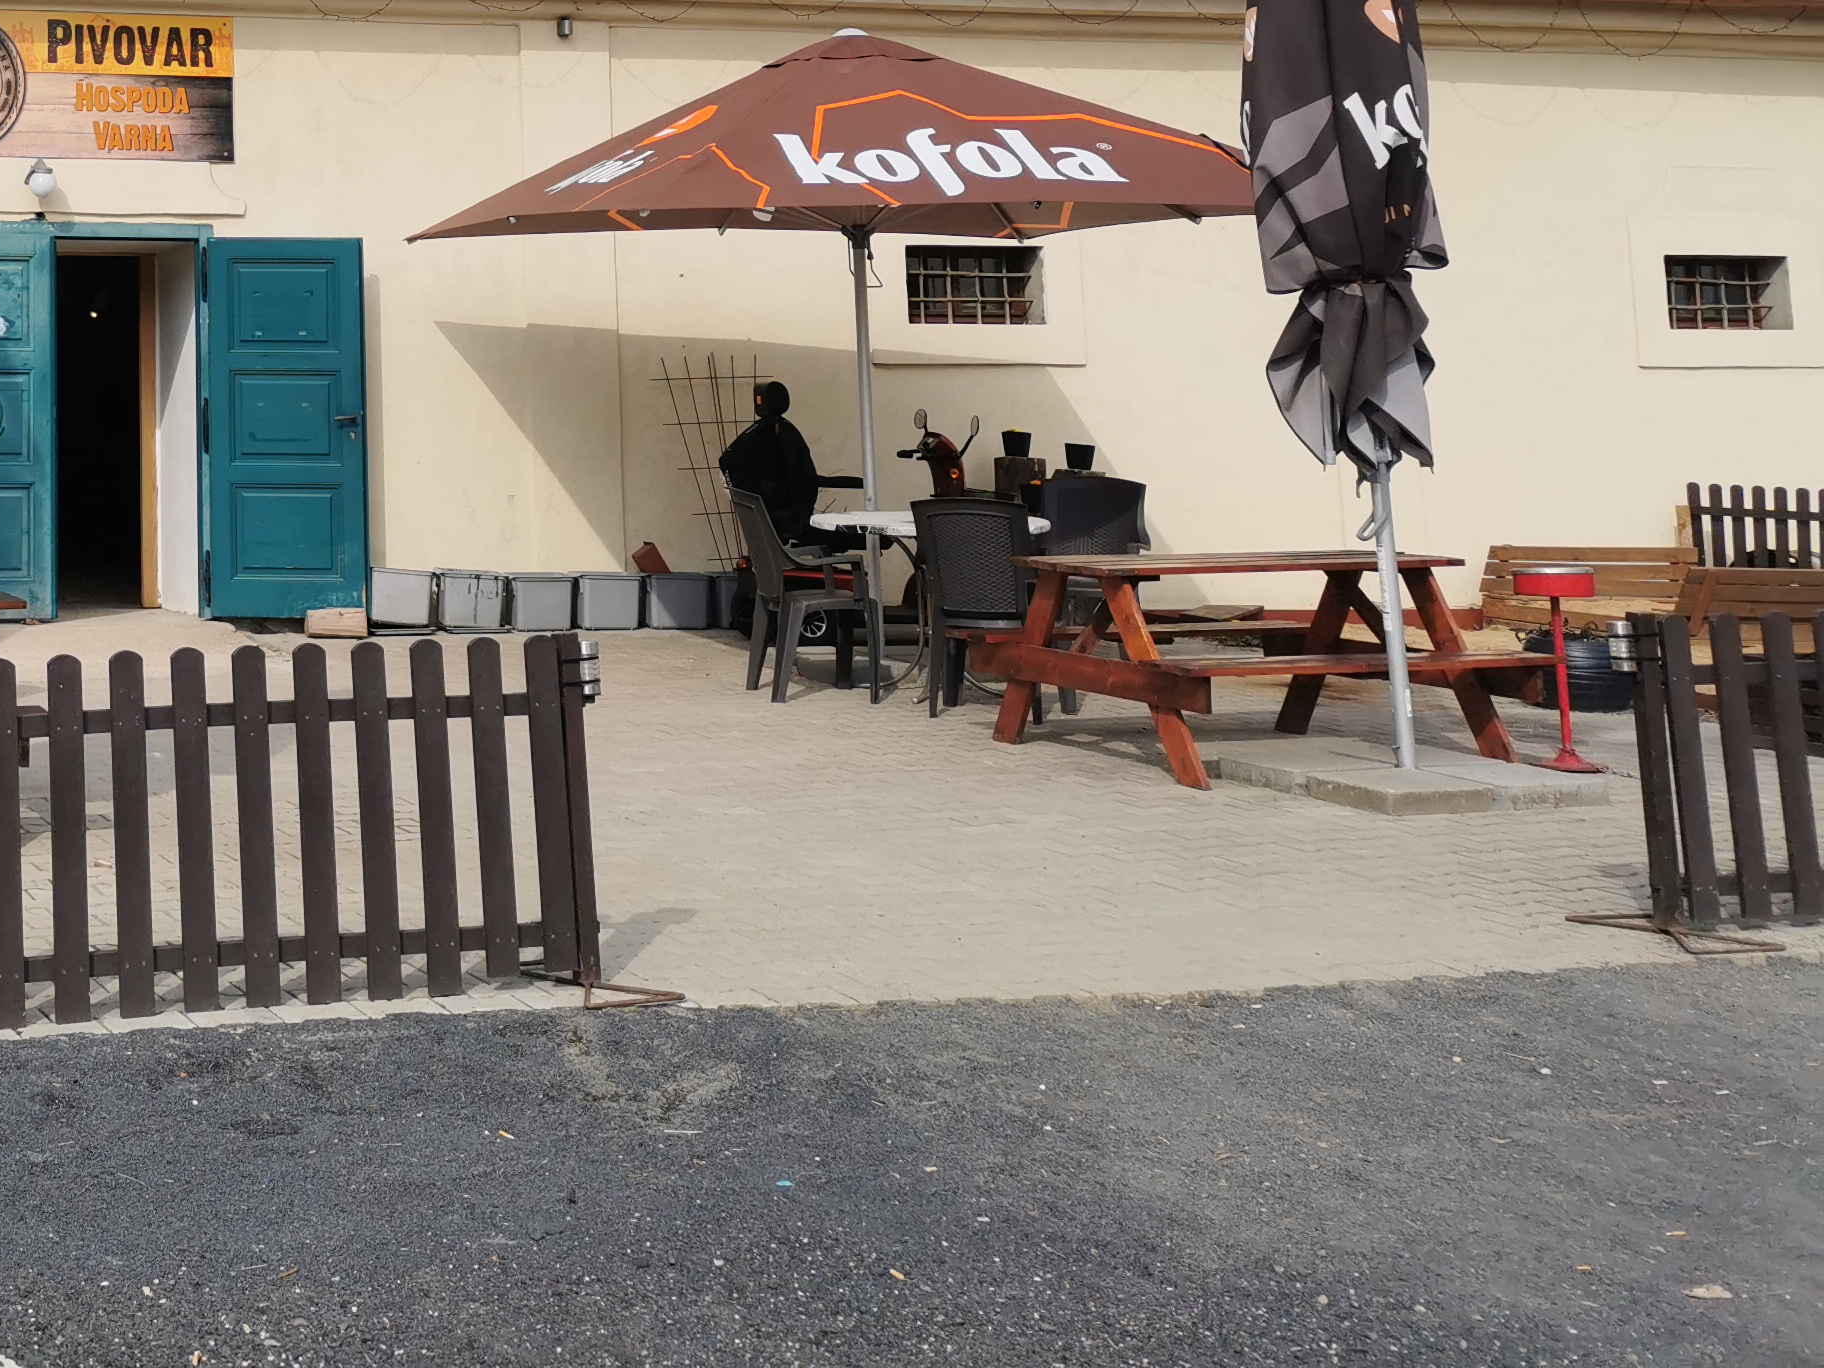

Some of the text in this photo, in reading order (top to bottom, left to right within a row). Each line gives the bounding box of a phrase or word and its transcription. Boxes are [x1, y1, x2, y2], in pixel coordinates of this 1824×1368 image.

[48, 19, 213, 67] PIVOVAR
[76, 82, 190, 114] HOSPODA
[93, 120, 174, 151] VARNA
[773, 127, 1130, 197] kofola
